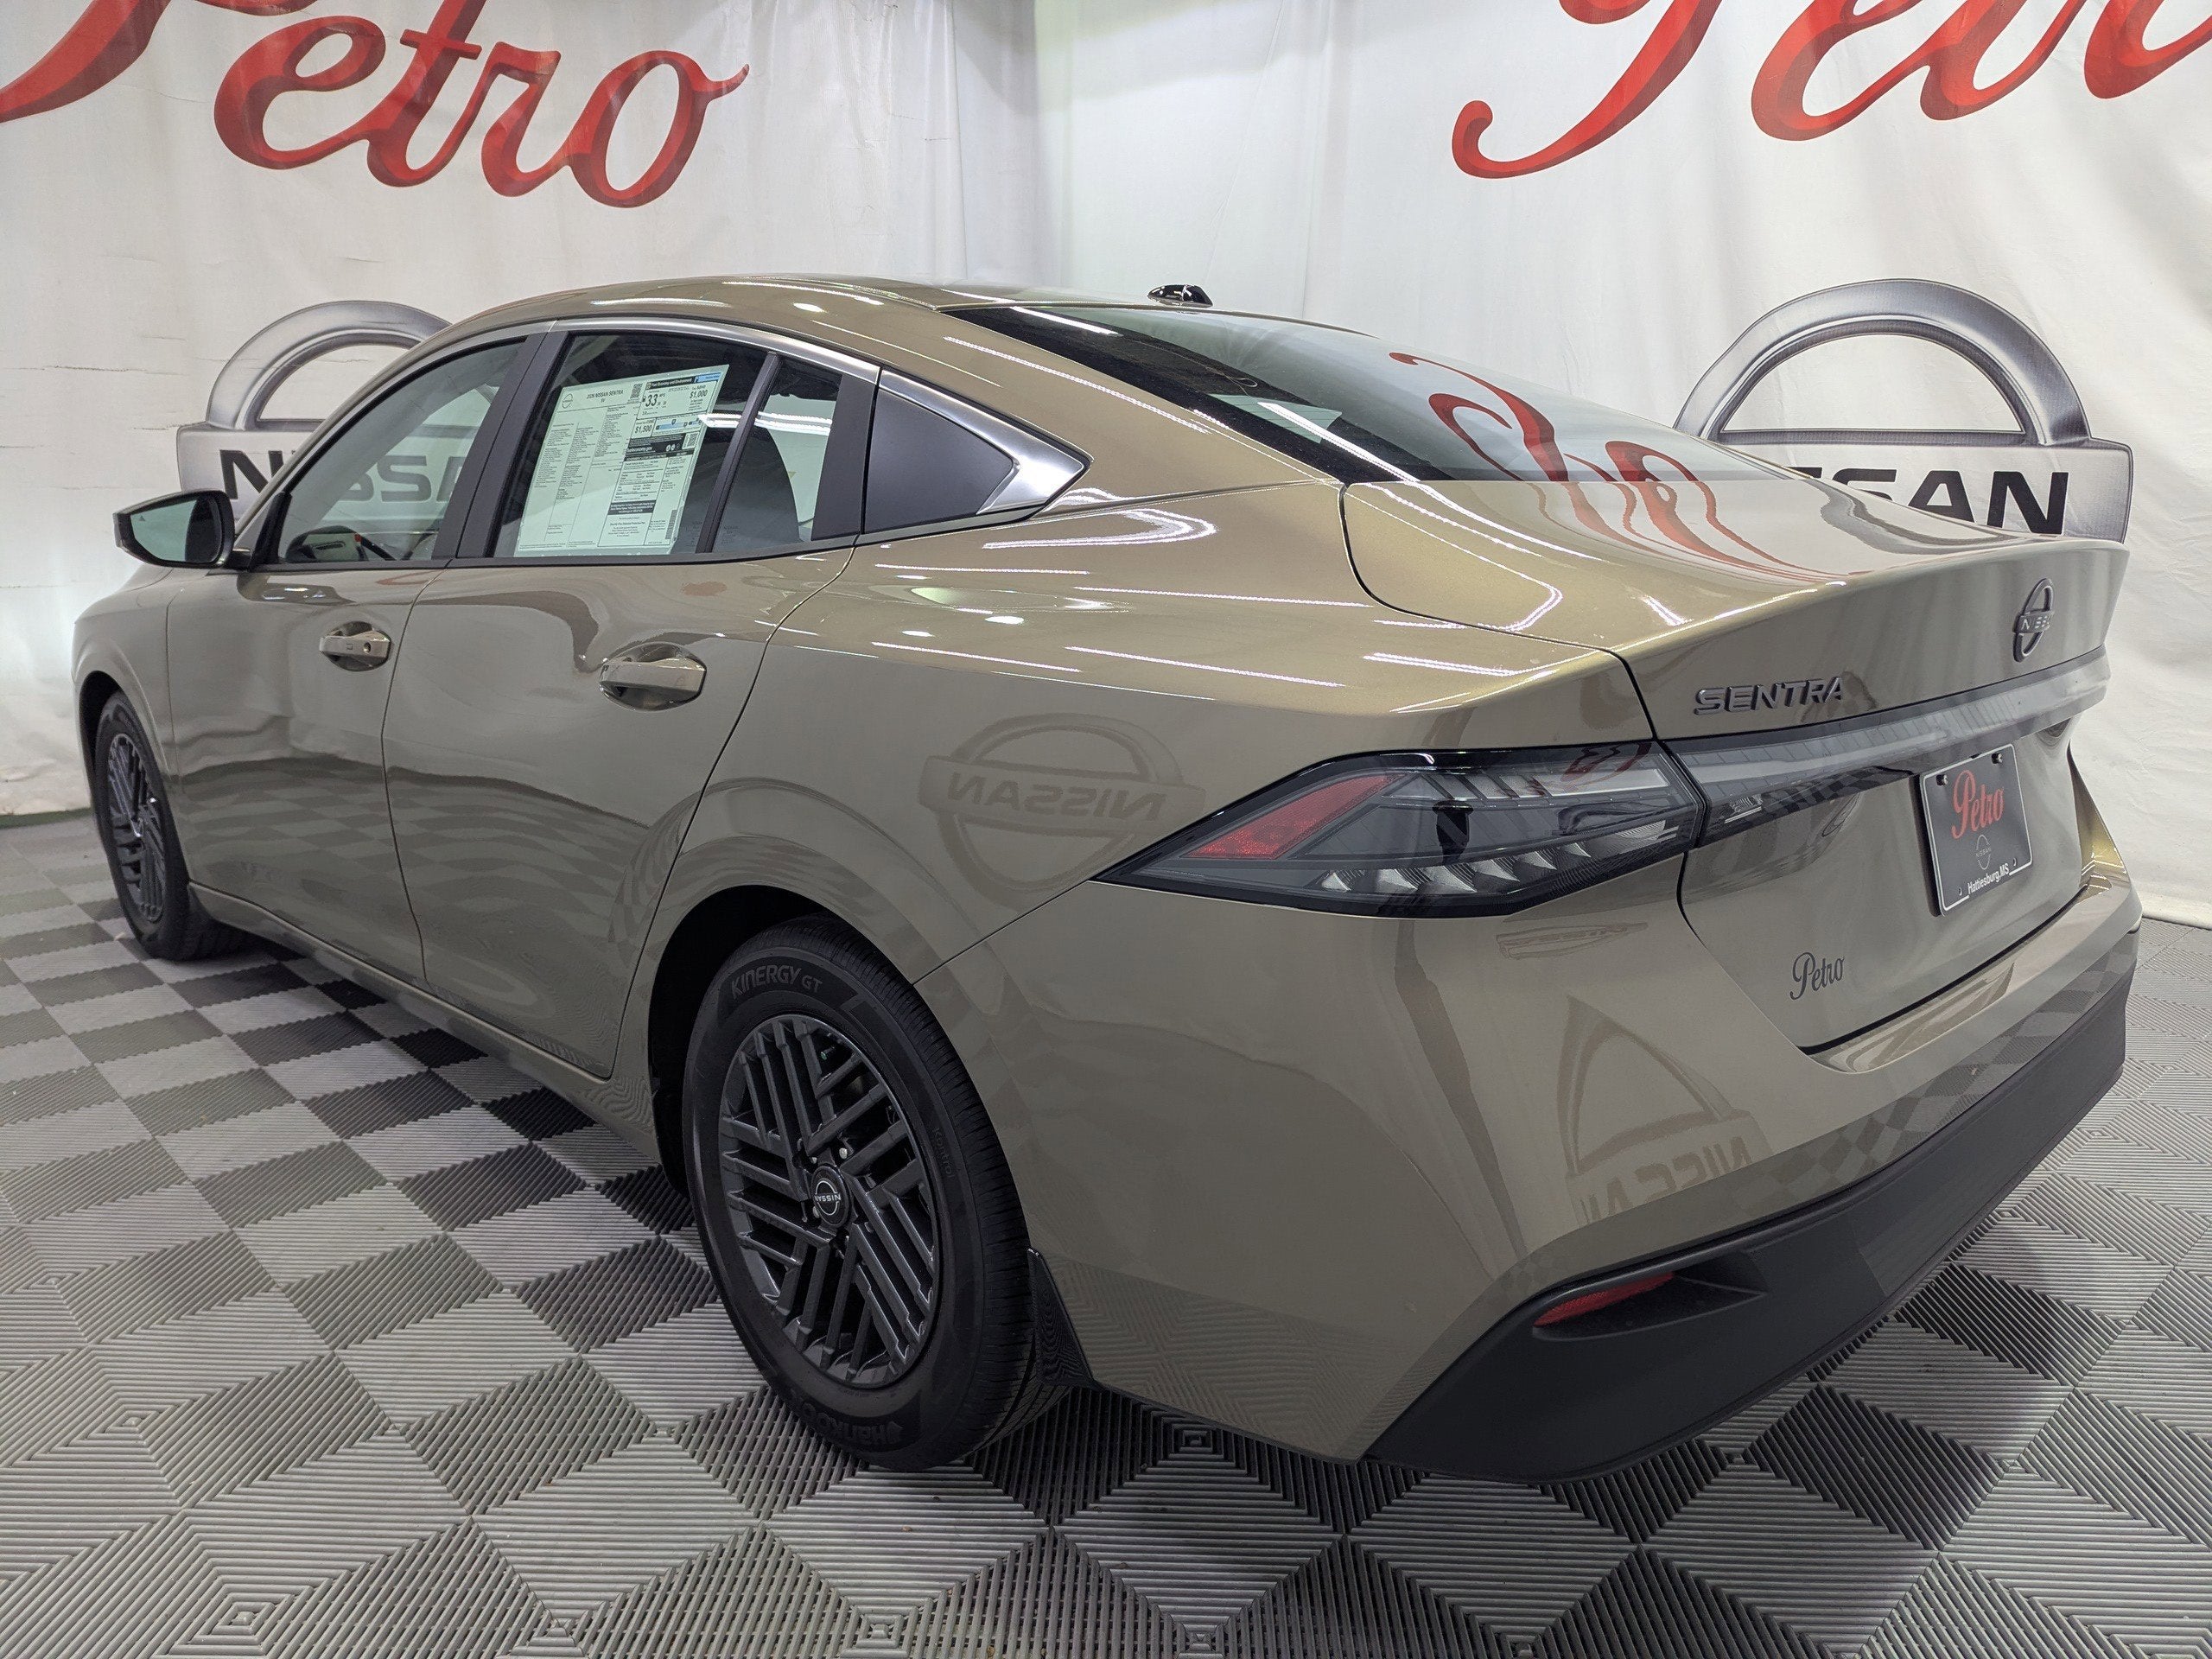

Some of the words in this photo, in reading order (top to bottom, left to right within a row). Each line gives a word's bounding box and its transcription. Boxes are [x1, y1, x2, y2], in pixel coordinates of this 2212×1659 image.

[645, 393, 658, 407] 33
[690, 389, 709, 399] $1,000
[635, 425, 652, 435] $1,500
[1694, 677, 1844, 716] SENTRA
[1951, 769, 2005, 839] Petro
[802, 974, 823, 994] GT
[1789, 951, 1845, 1001] Petro
[814, 1192, 842, 1202] NISSAN
